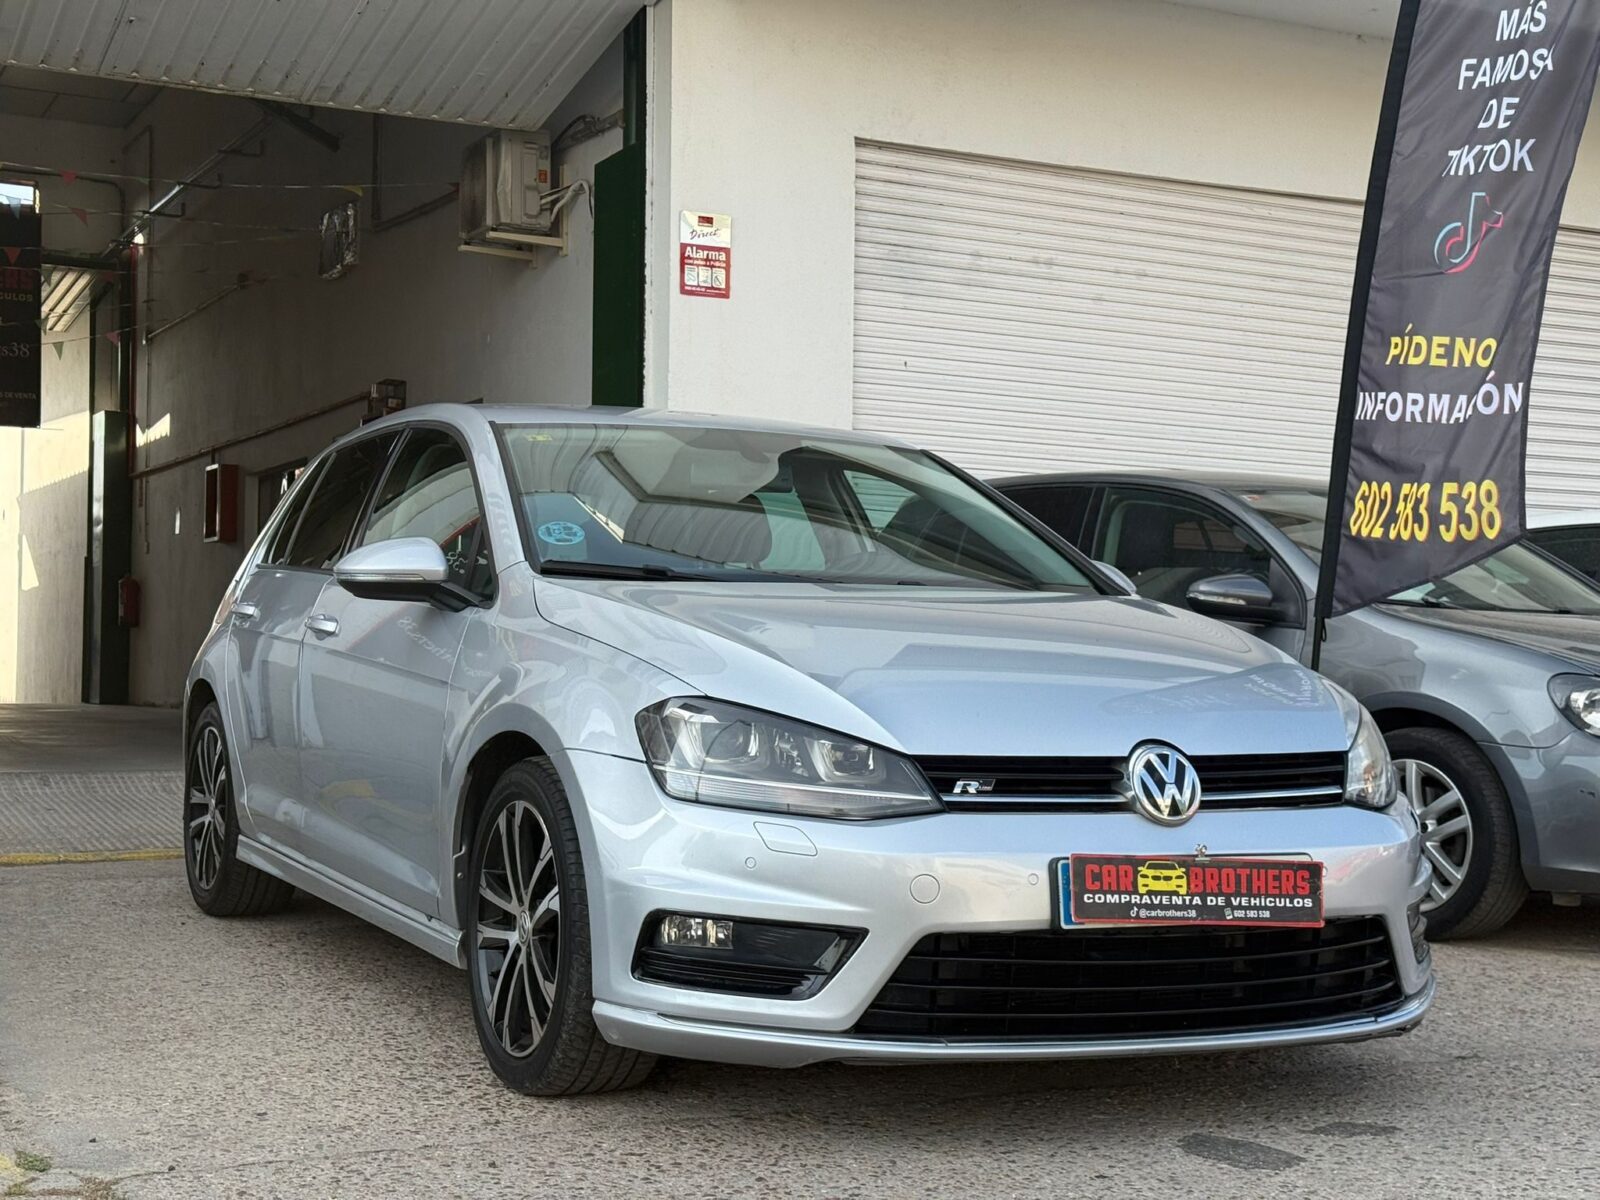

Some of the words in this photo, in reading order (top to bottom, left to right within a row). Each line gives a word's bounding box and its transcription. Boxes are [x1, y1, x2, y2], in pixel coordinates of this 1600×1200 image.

[1496, 0, 1547, 41] MÁS
[1477, 97, 1520, 129] DE
[1442, 138, 1536, 177] TIKTOK
[685, 246, 726, 261] Alarma
[1350, 480, 1391, 538] 602
[1389, 481, 1430, 542] 583
[1439, 479, 1502, 542] 538
[952, 780, 979, 794] R
[1085, 864, 1134, 892] CAR
[1188, 866, 1311, 895] BROTHERS
[1083, 893, 1203, 906] COMPRAVENTA
[1206, 896, 1226, 907] DE
[1230, 895, 1313, 908] VEHÍCULOS
[1139, 908, 1197, 918] @carbrothers38
